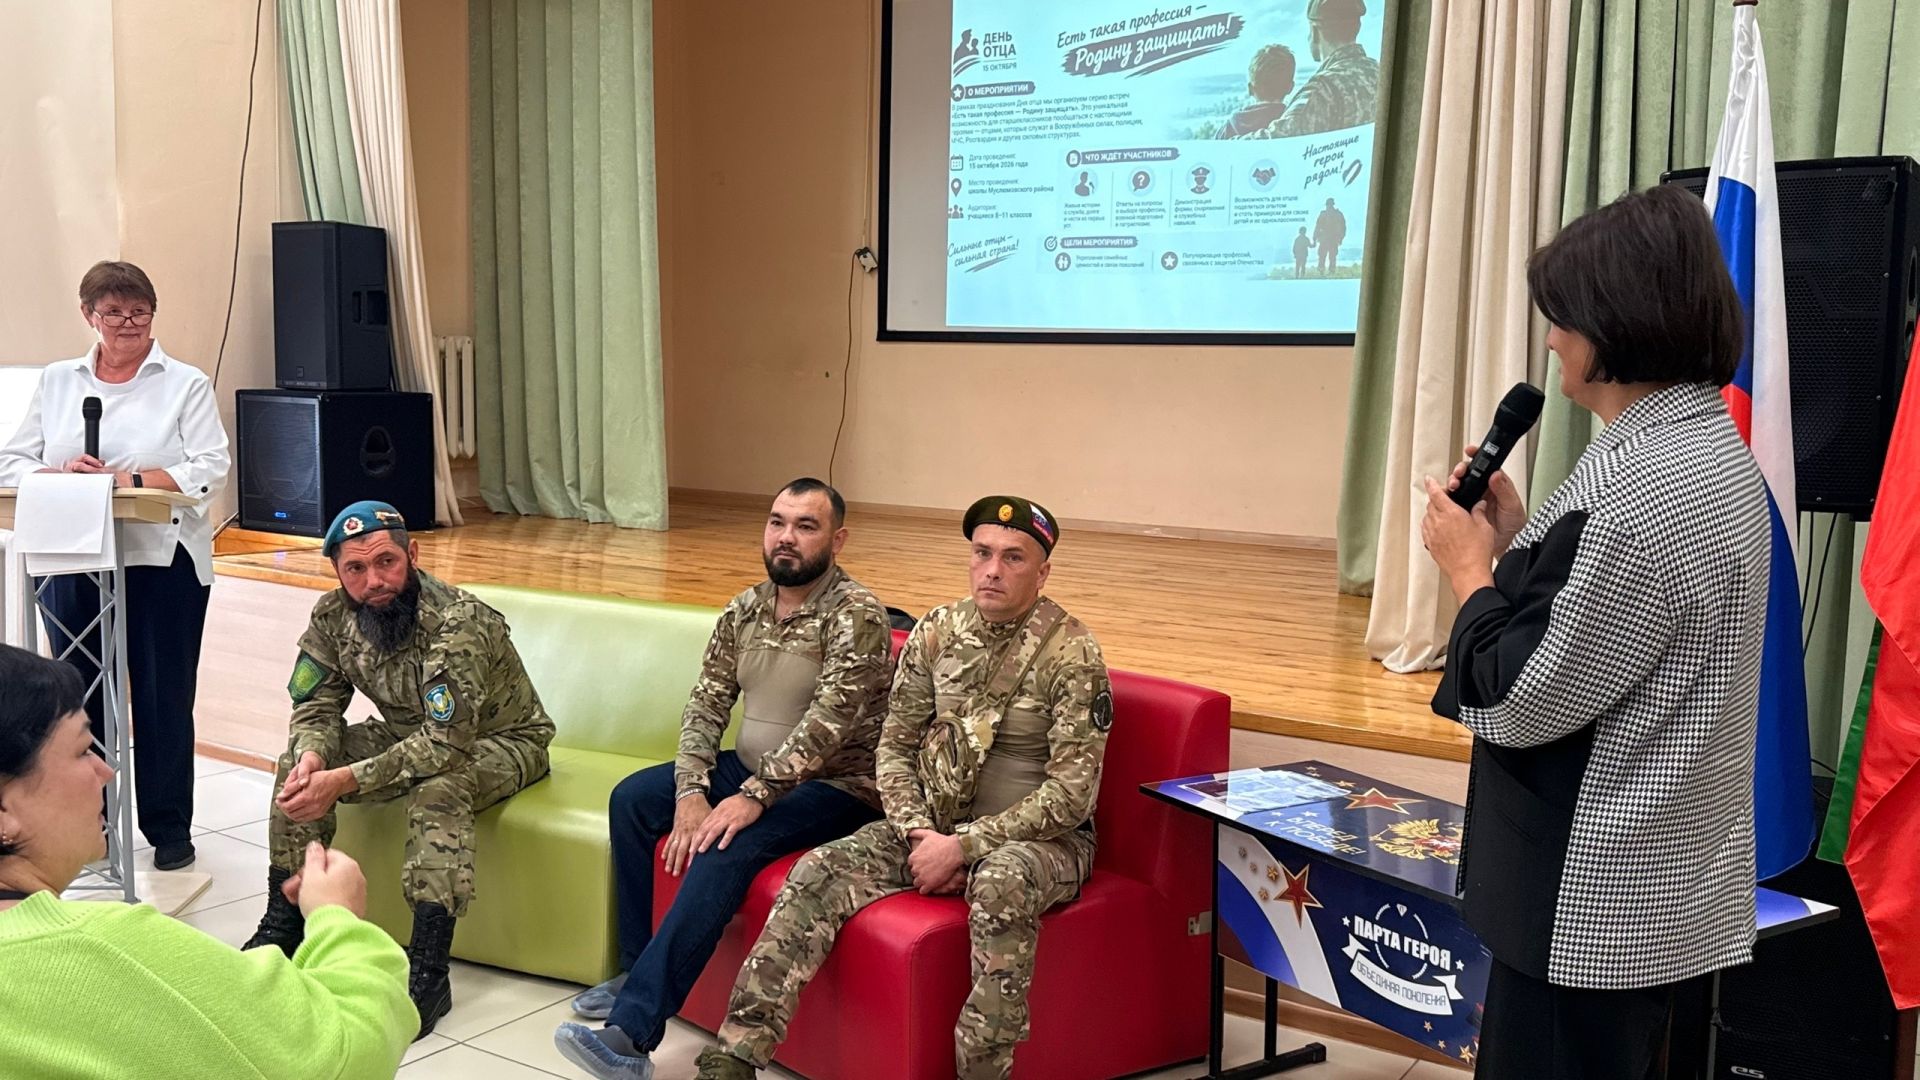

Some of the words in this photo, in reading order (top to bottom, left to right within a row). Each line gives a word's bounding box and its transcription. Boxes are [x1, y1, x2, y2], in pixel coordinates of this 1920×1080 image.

[1057, 32, 1086, 48] Есть
[1090, 22, 1126, 39] такая
[1130, 5, 1192, 32] профессия
[983, 31, 1012, 46] ДЕНЬ
[1074, 42, 1133, 74] Родину
[1133, 14, 1232, 64] защищать!
[983, 44, 1017, 58] ОТЦА
[990, 62, 1017, 71] ОКТЯБРЯ
[975, 84, 1028, 96] МЕРОПРИЯТИИ
[1054, 96, 1087, 104] организуем
[1109, 93, 1130, 101] встреч
[984, 108, 1014, 119] профессия
[1093, 102, 1128, 111] уникальная
[1085, 153, 1100, 162] ЧТО
[1123, 150, 1172, 160] УЧАСТНИКОВ
[1302, 136, 1359, 160] Настоящие
[977, 162, 999, 170] октября
[1314, 151, 1344, 168] герои
[1304, 161, 1344, 190] рядом!
[948, 242, 982, 258] Сильные
[984, 236, 1006, 250] отцы
[954, 250, 987, 267] сильная
[989, 238, 1020, 260] страна!
[1280, 826, 1367, 856] ПОБЕДЕ!
[1354, 914, 1402, 952] ПАРТА
[1404, 936, 1451, 972] ГЕРОЯ
[1356, 960, 1400, 994] ОБЪЕДИНЯЯ
[1402, 986, 1446, 1006] ПОКОЛЕНИЯ
